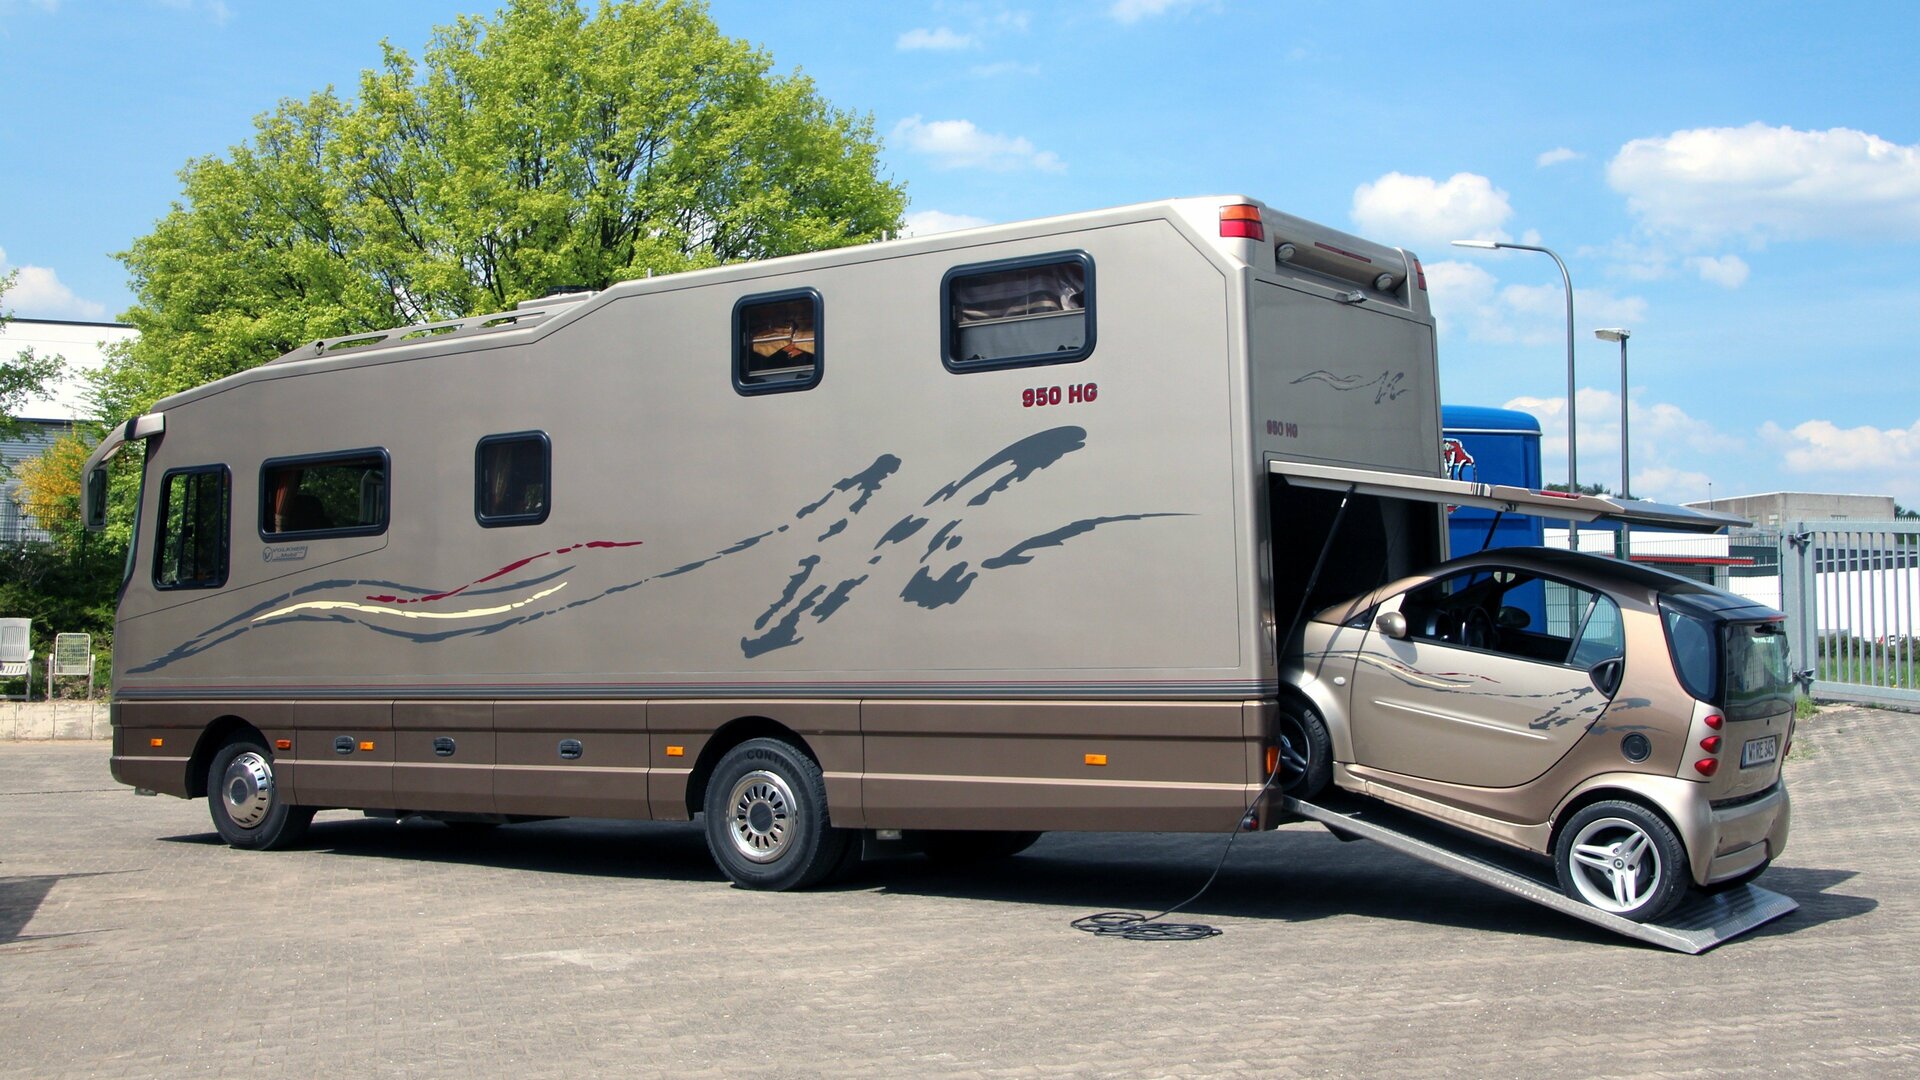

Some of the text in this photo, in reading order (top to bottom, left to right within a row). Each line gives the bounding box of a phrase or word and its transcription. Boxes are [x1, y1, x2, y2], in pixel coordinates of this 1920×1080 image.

[1022, 382, 1098, 408] 950 HG
[1266, 419, 1284, 436] 950
